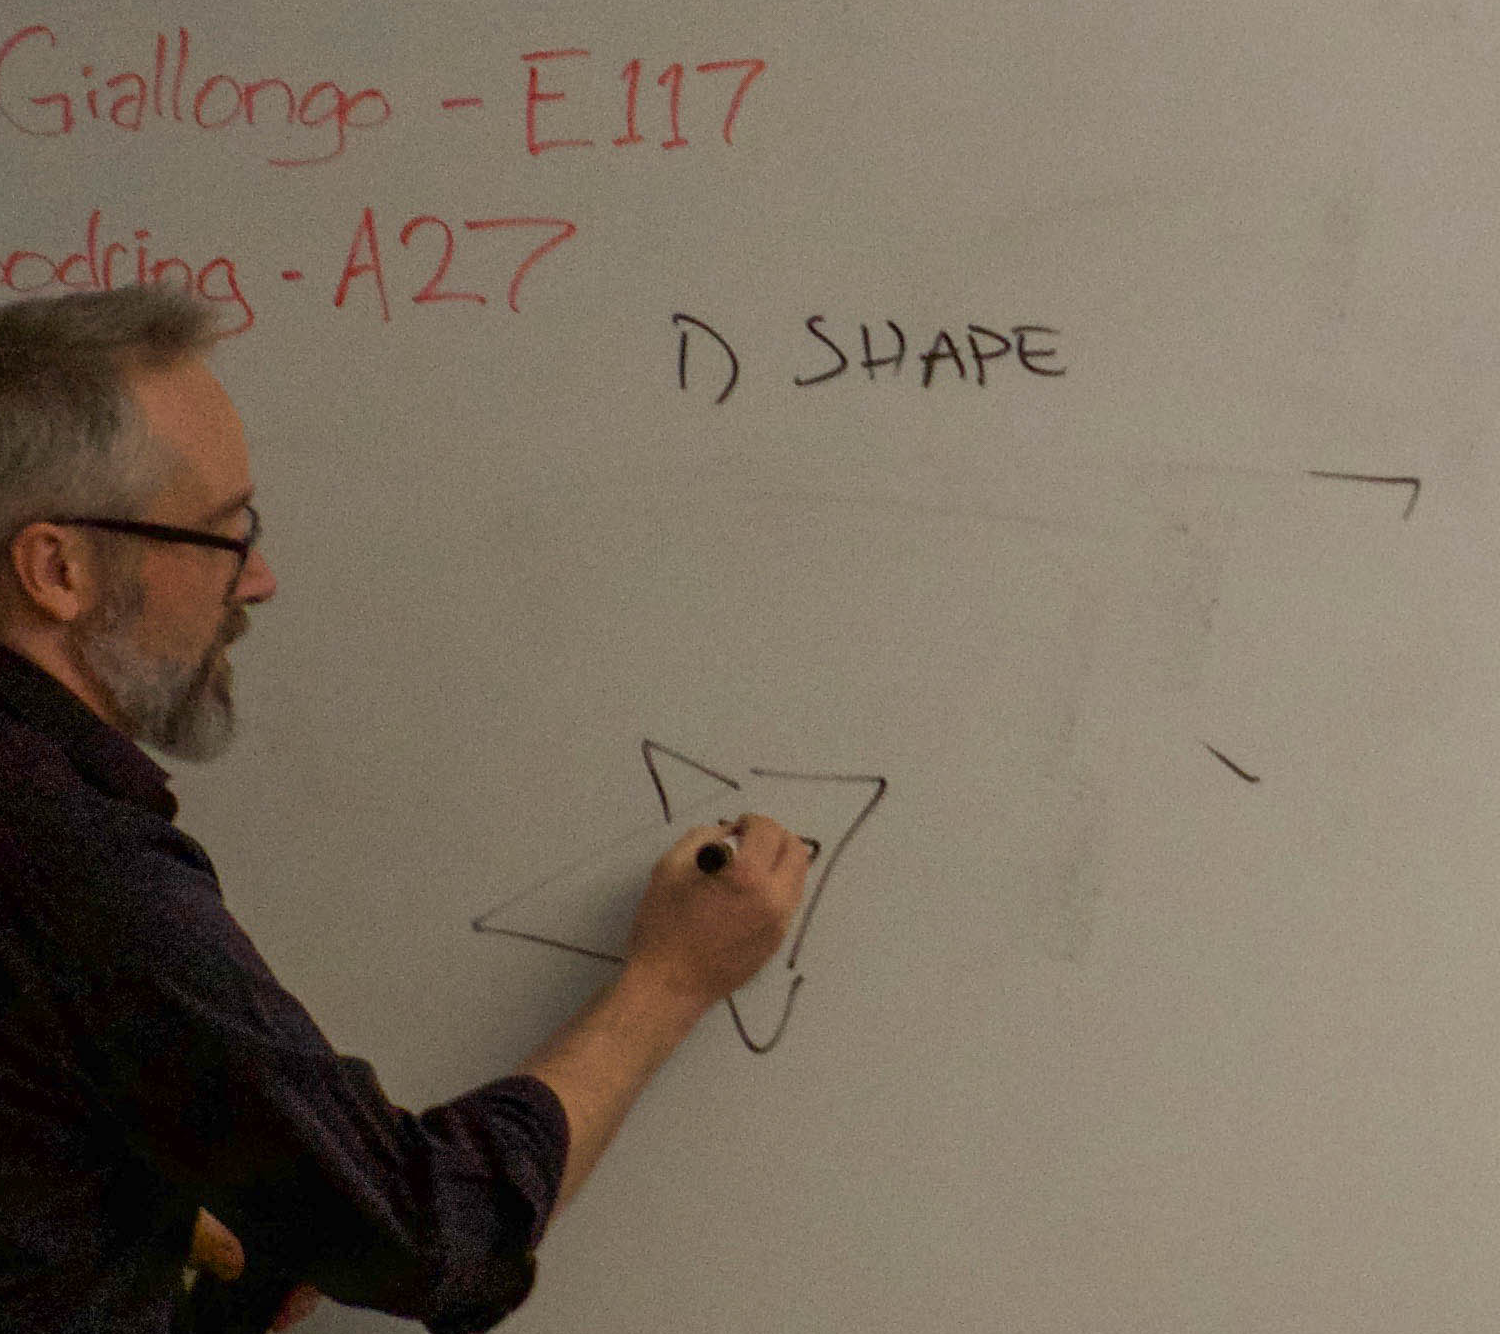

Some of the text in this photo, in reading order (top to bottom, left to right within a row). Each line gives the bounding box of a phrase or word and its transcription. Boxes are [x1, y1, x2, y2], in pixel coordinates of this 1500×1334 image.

[521, 48, 769, 157] E117
[333, 207, 578, 319] A27
[793, 314, 1068, 389] SHAPE
